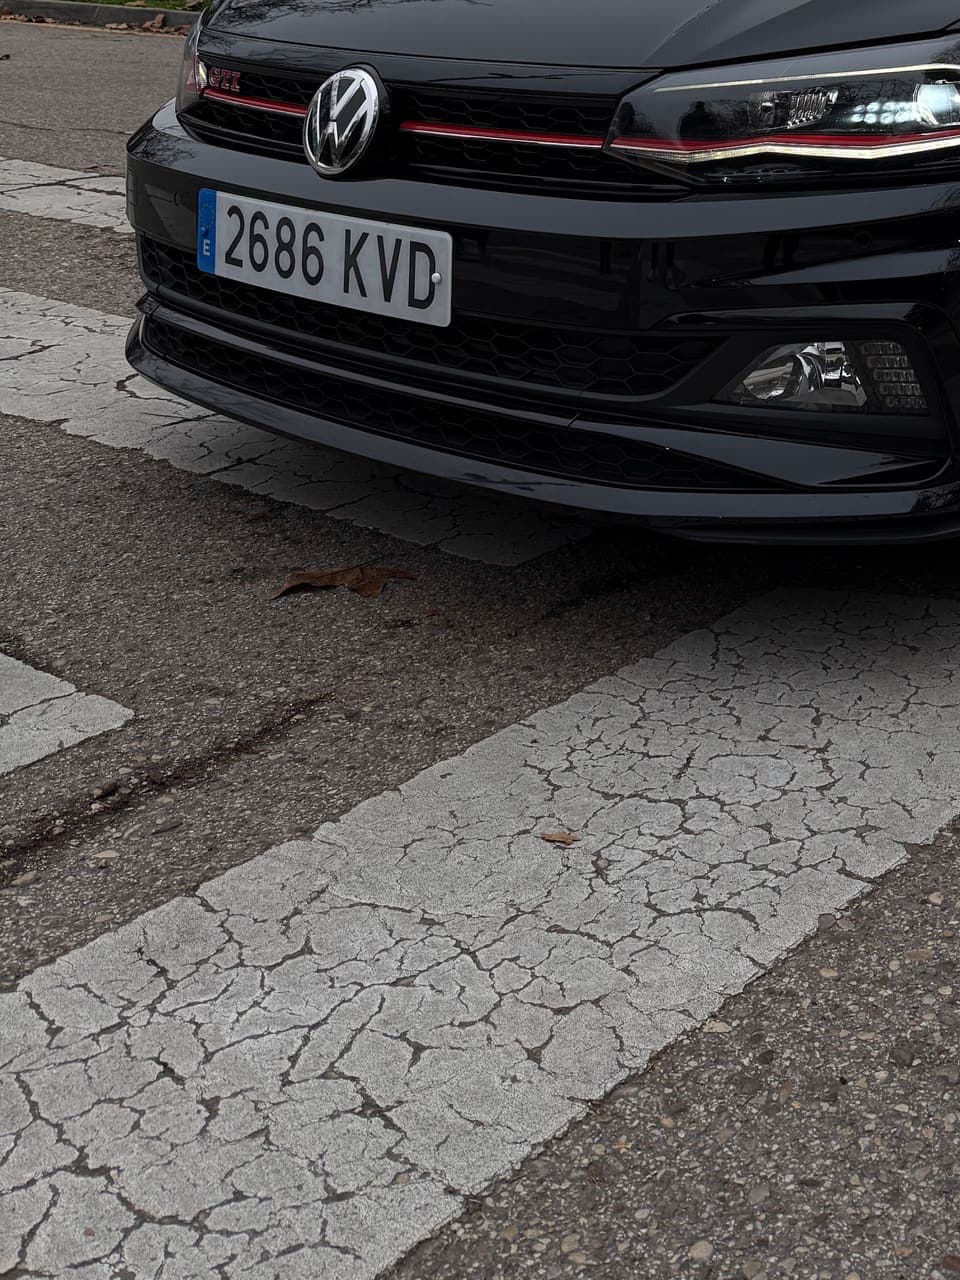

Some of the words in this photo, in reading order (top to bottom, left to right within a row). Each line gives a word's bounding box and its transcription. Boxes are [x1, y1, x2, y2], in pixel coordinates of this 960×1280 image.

[208, 66, 242, 93] GTI
[203, 239, 211, 257] E
[224, 204, 325, 287] 2686
[342, 228, 437, 310] KVD
